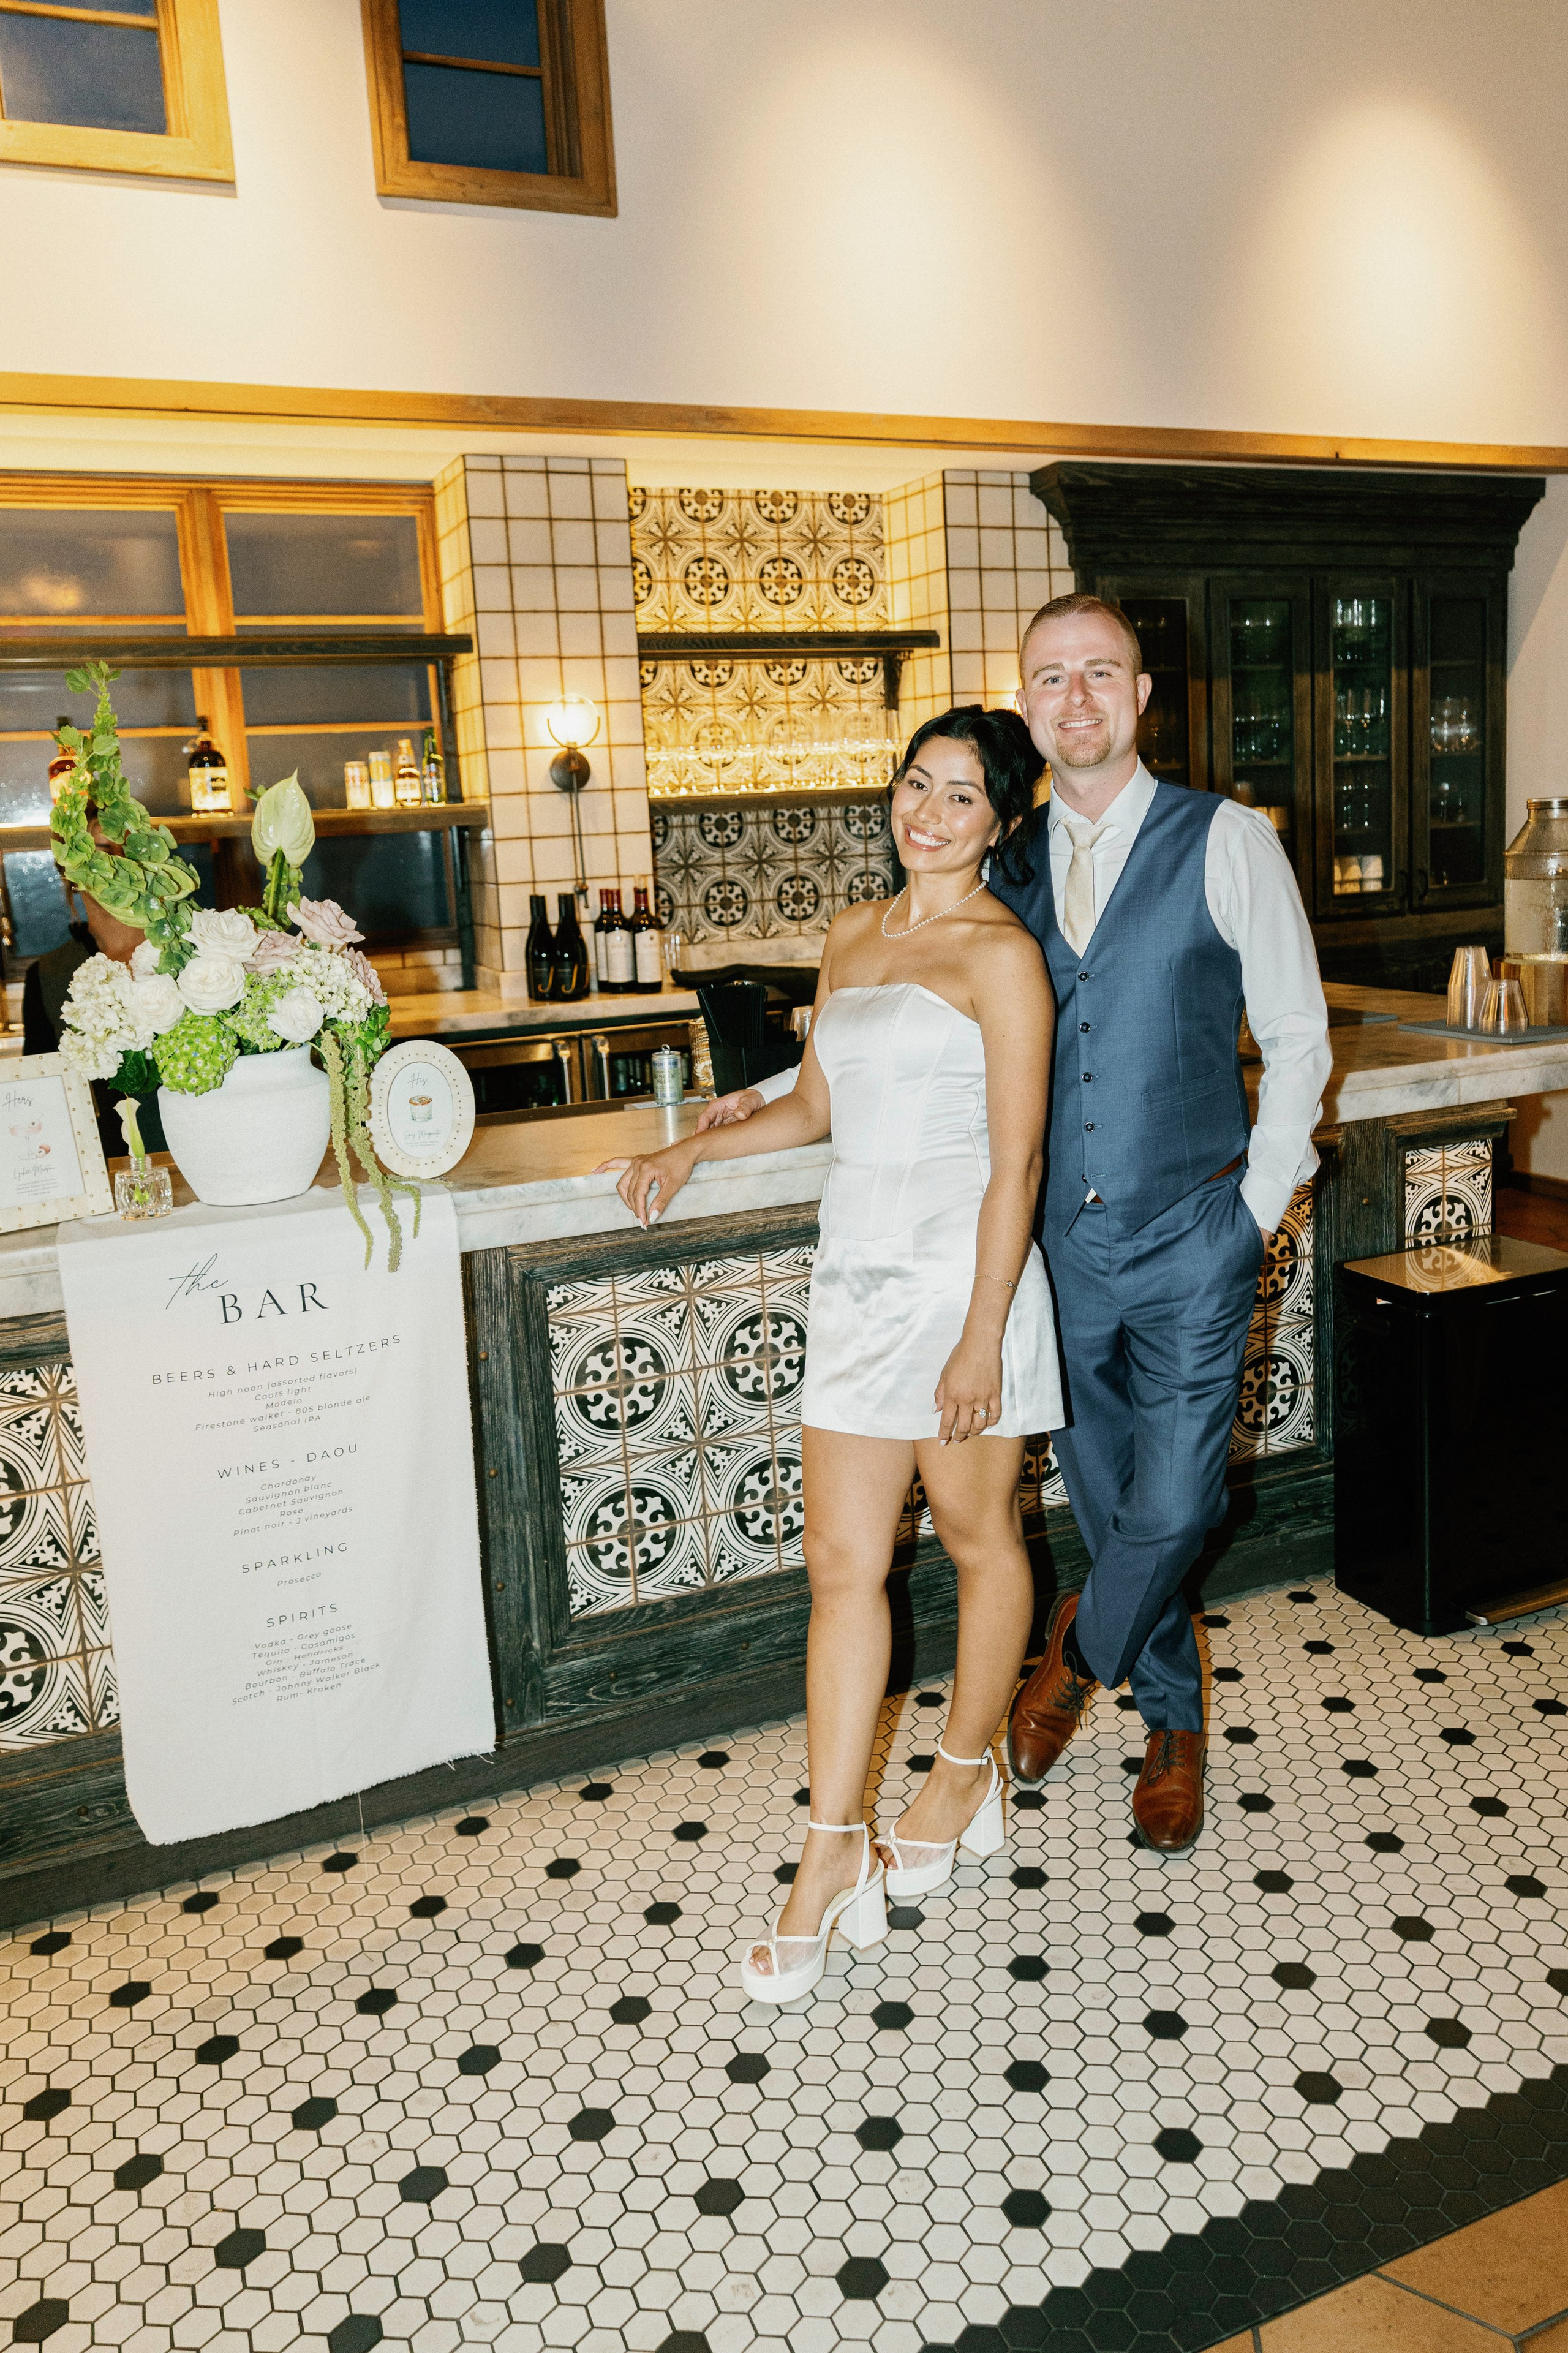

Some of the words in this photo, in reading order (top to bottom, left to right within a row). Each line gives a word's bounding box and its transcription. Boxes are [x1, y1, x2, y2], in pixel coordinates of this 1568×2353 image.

[2, 1090, 34, 1112] Hers
[165, 1253, 228, 1309] the
[217, 1283, 330, 1324] BAR
[153, 1369, 216, 1384] BEERS
[227, 1365, 236, 1376] &
[248, 1356, 300, 1372] HARD
[311, 1335, 401, 1362] SELTZERS
[208, 1386, 233, 1399] High
[237, 1383, 263, 1394] noon
[267, 1375, 315, 1391] (assorted
[319, 1367, 358, 1381] flavors)
[255, 1389, 284, 1402] Coors
[287, 1386, 312, 1397] light
[195, 1418, 246, 1431] Firestone
[250, 1411, 284, 1423] walker
[295, 1405, 314, 1416] 805
[317, 1398, 352, 1412] blonde
[356, 1395, 371, 1403] ale
[266, 1397, 303, 1410] Modelo
[254, 1418, 300, 1432] Seasonal
[304, 1414, 321, 1424] IPA
[217, 1459, 280, 1479] WINES
[307, 1444, 358, 1462] DAOU
[246, 1488, 300, 1503] Sauvignon
[304, 1482, 333, 1492] blanc
[260, 1474, 317, 1490] Chardonay
[238, 1500, 287, 1515] Cabernet
[291, 1489, 344, 1505] Sauvignon
[280, 1508, 303, 1517] Rose
[233, 1526, 261, 1536] Pinot
[265, 1520, 285, 1530] noir
[305, 1506, 353, 1521] vineyards
[242, 1543, 347, 1573] SPARKLING
[277, 1572, 322, 1586] Prosecco
[267, 1603, 337, 1628] SPIRITS
[252, 1648, 290, 1659] Tequila
[301, 1633, 356, 1650] Casamigos
[255, 1639, 286, 1649] Vodka
[297, 1631, 320, 1641] Grey
[323, 1624, 352, 1636] goose
[257, 1664, 299, 1677] Whiskey
[309, 1653, 353, 1665] Jameson
[294, 1645, 344, 1660] Hendricks
[232, 1690, 265, 1705] Scotch
[276, 1680, 312, 1692] Johnny
[316, 1671, 350, 1683] Walker
[354, 1663, 381, 1674] Black
[245, 1675, 288, 1690] Bourbon
[300, 1666, 336, 1678] Buffalo
[340, 1658, 366, 1669] Trace
[307, 1683, 342, 1694] Kraken
